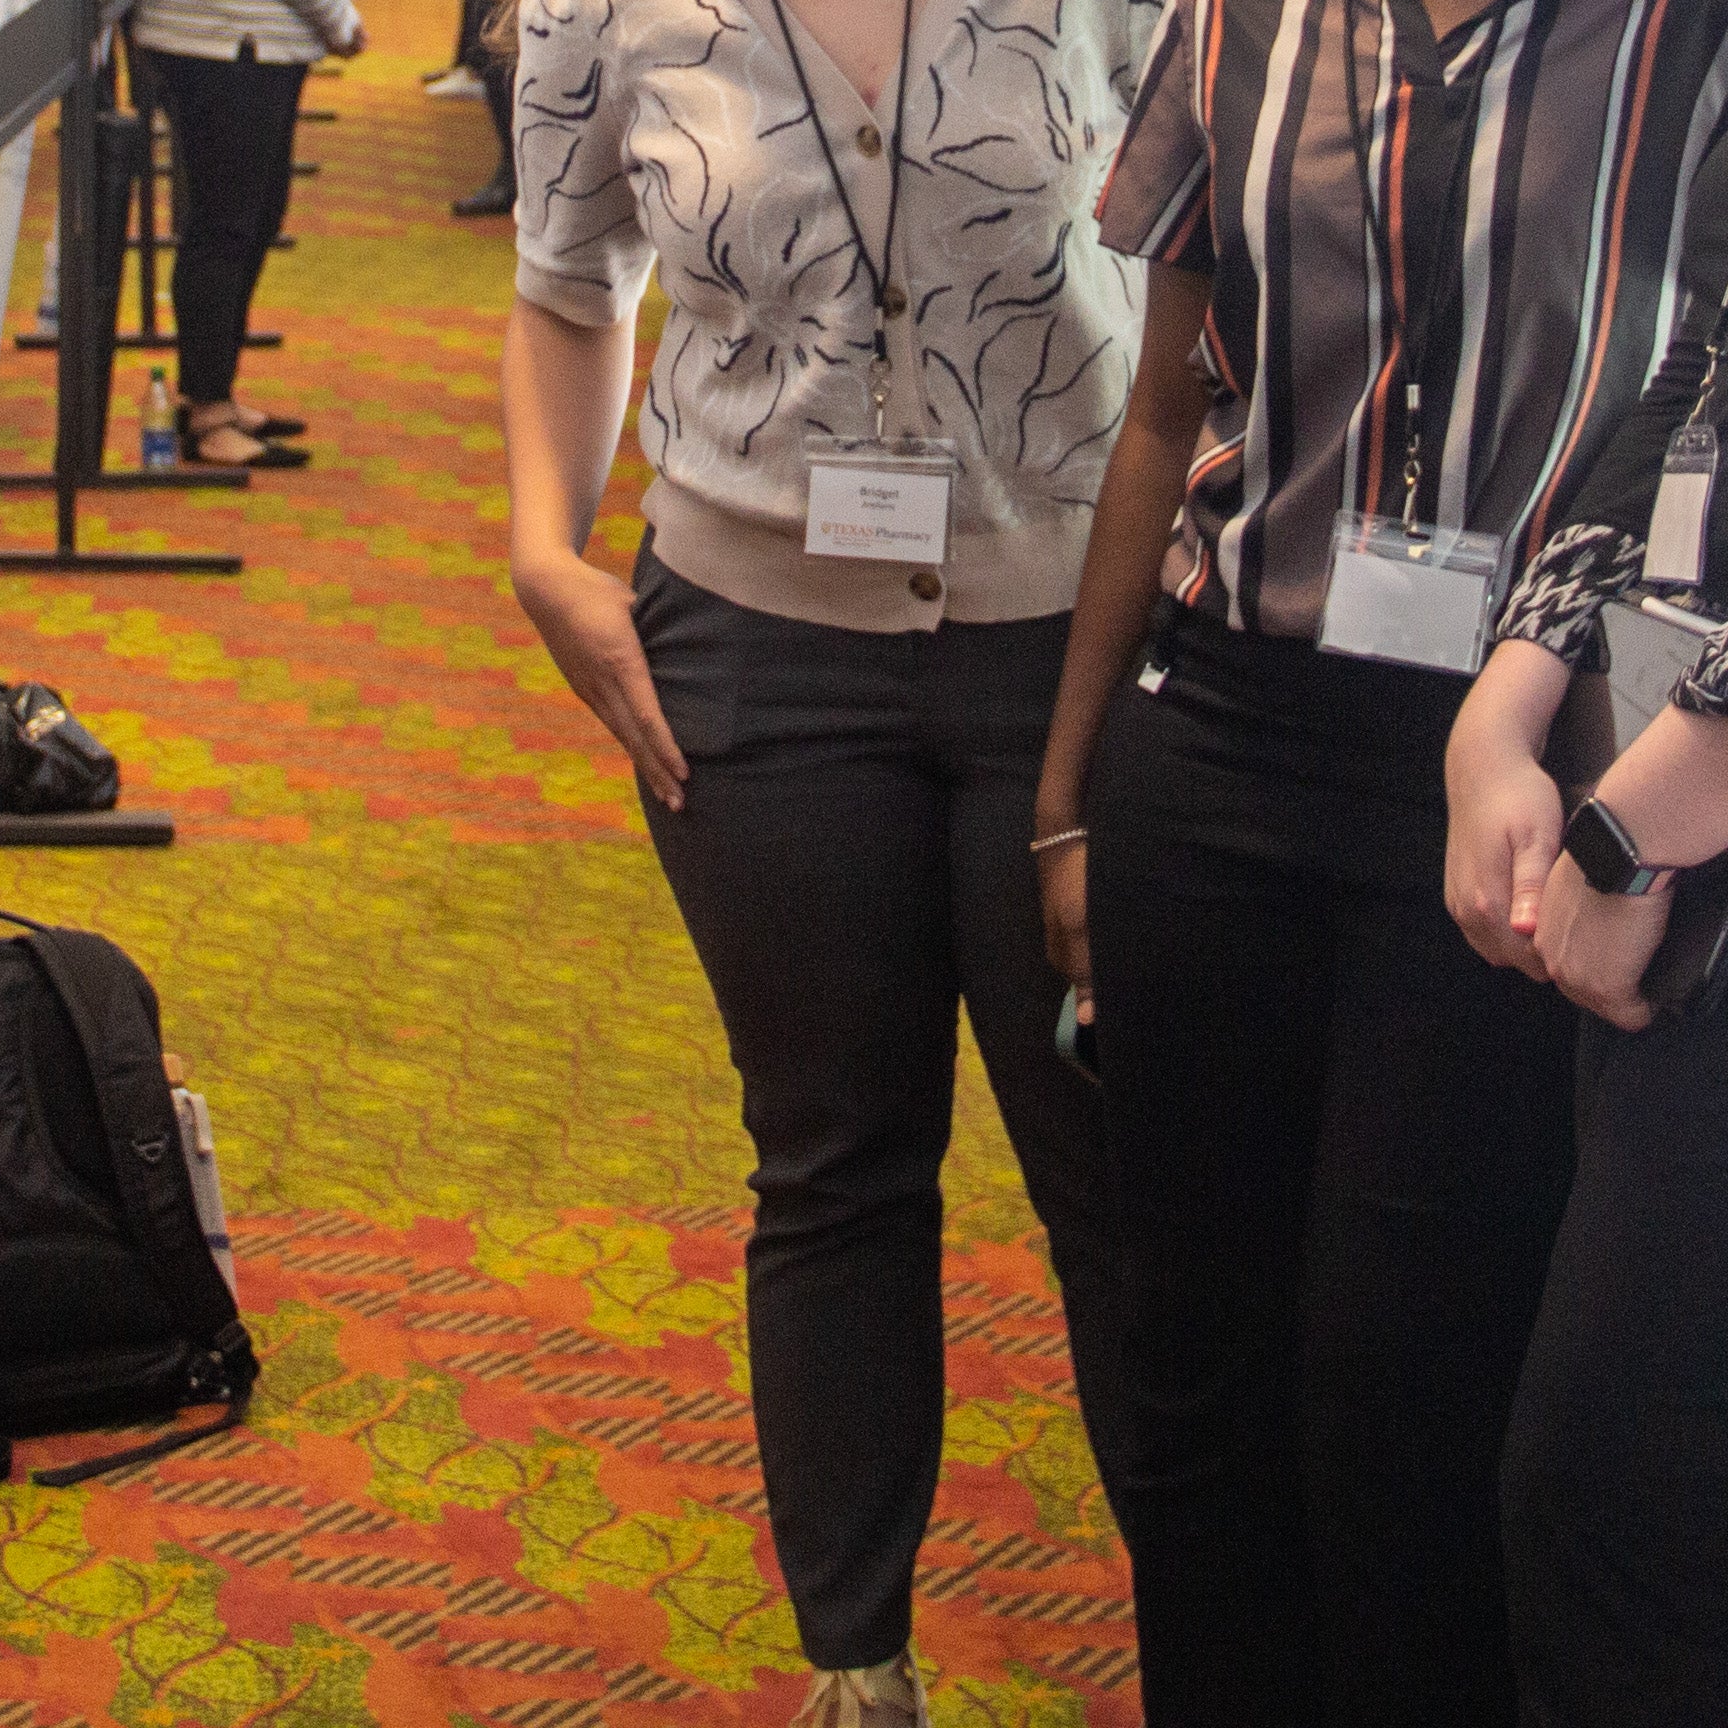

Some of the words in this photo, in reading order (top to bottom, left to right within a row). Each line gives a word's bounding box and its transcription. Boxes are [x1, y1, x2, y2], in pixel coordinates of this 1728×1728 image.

[859, 485, 900, 502] Bridget
[831, 522, 872, 537] TEXAS
[874, 525, 933, 544] Pharmacy
